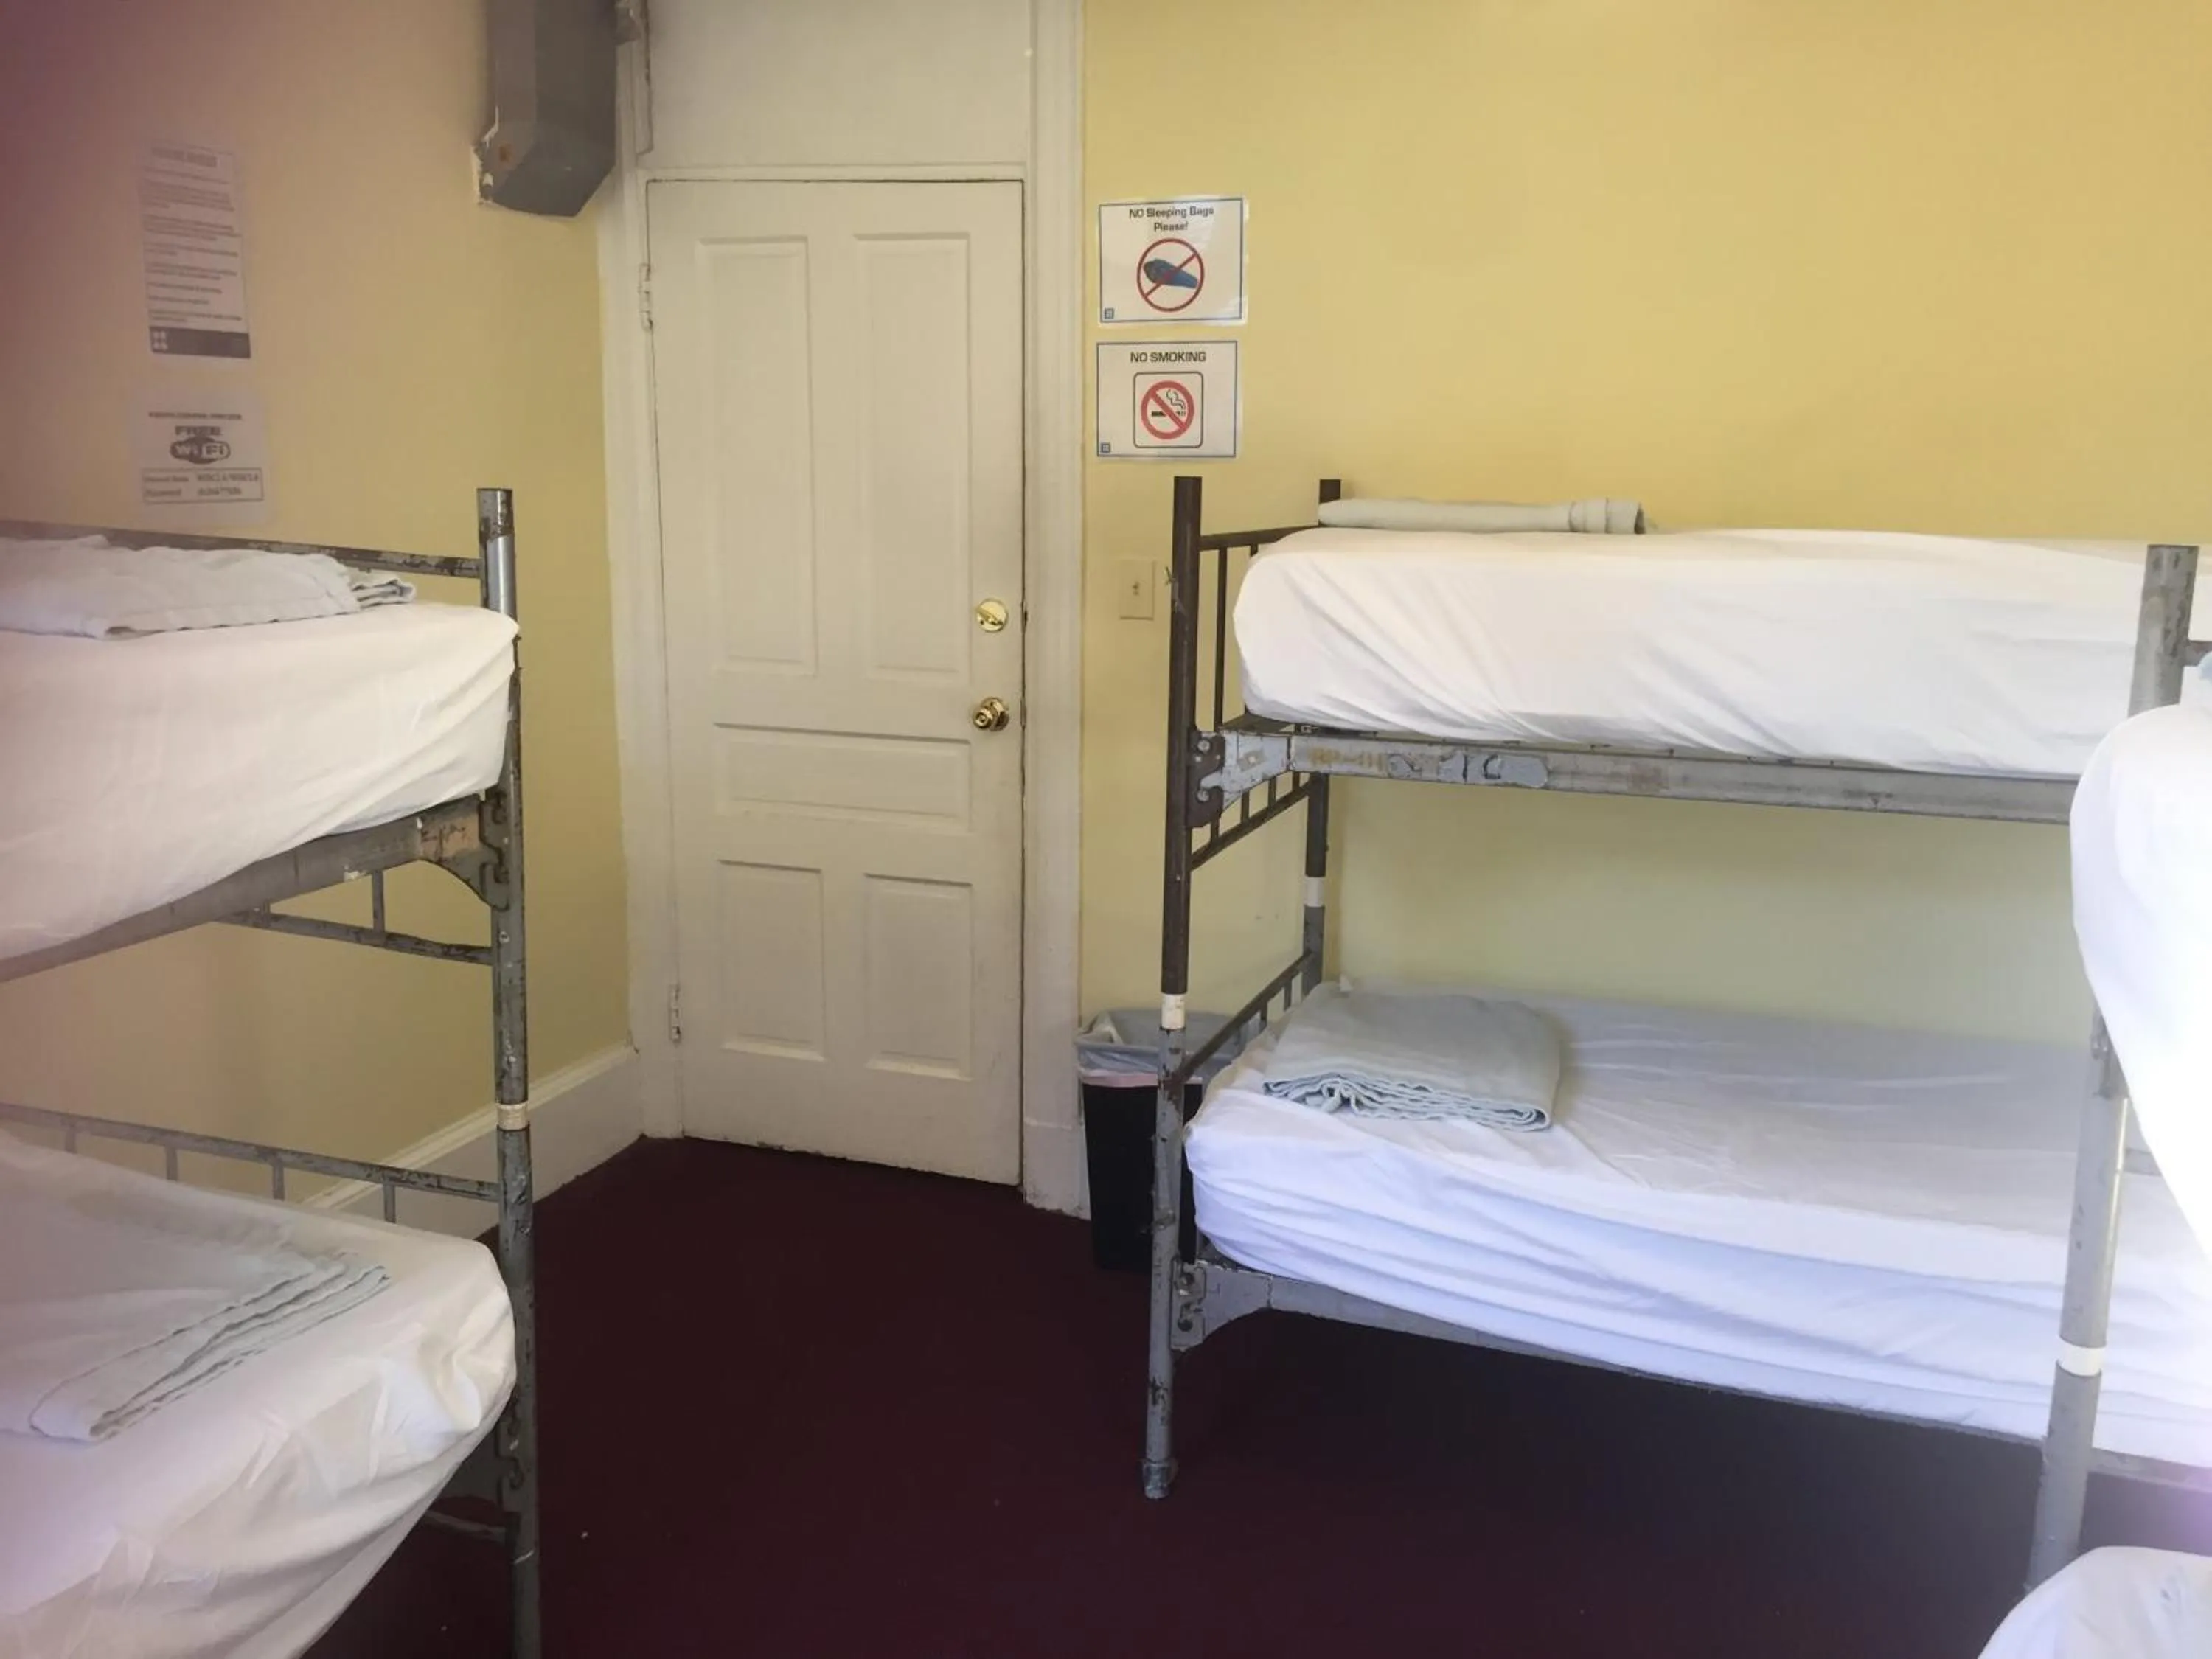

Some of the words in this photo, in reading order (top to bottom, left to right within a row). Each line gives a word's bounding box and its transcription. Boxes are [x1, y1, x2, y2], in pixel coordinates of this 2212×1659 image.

[1129, 209, 1144, 219] NO
[1147, 207, 1186, 218] Sleeping
[1189, 206, 1214, 218] Bags
[1154, 221, 1189, 232] Please!
[1130, 352, 1147, 363] NO
[1150, 351, 1206, 363] SMOKING
[175, 425, 221, 436] FREE
